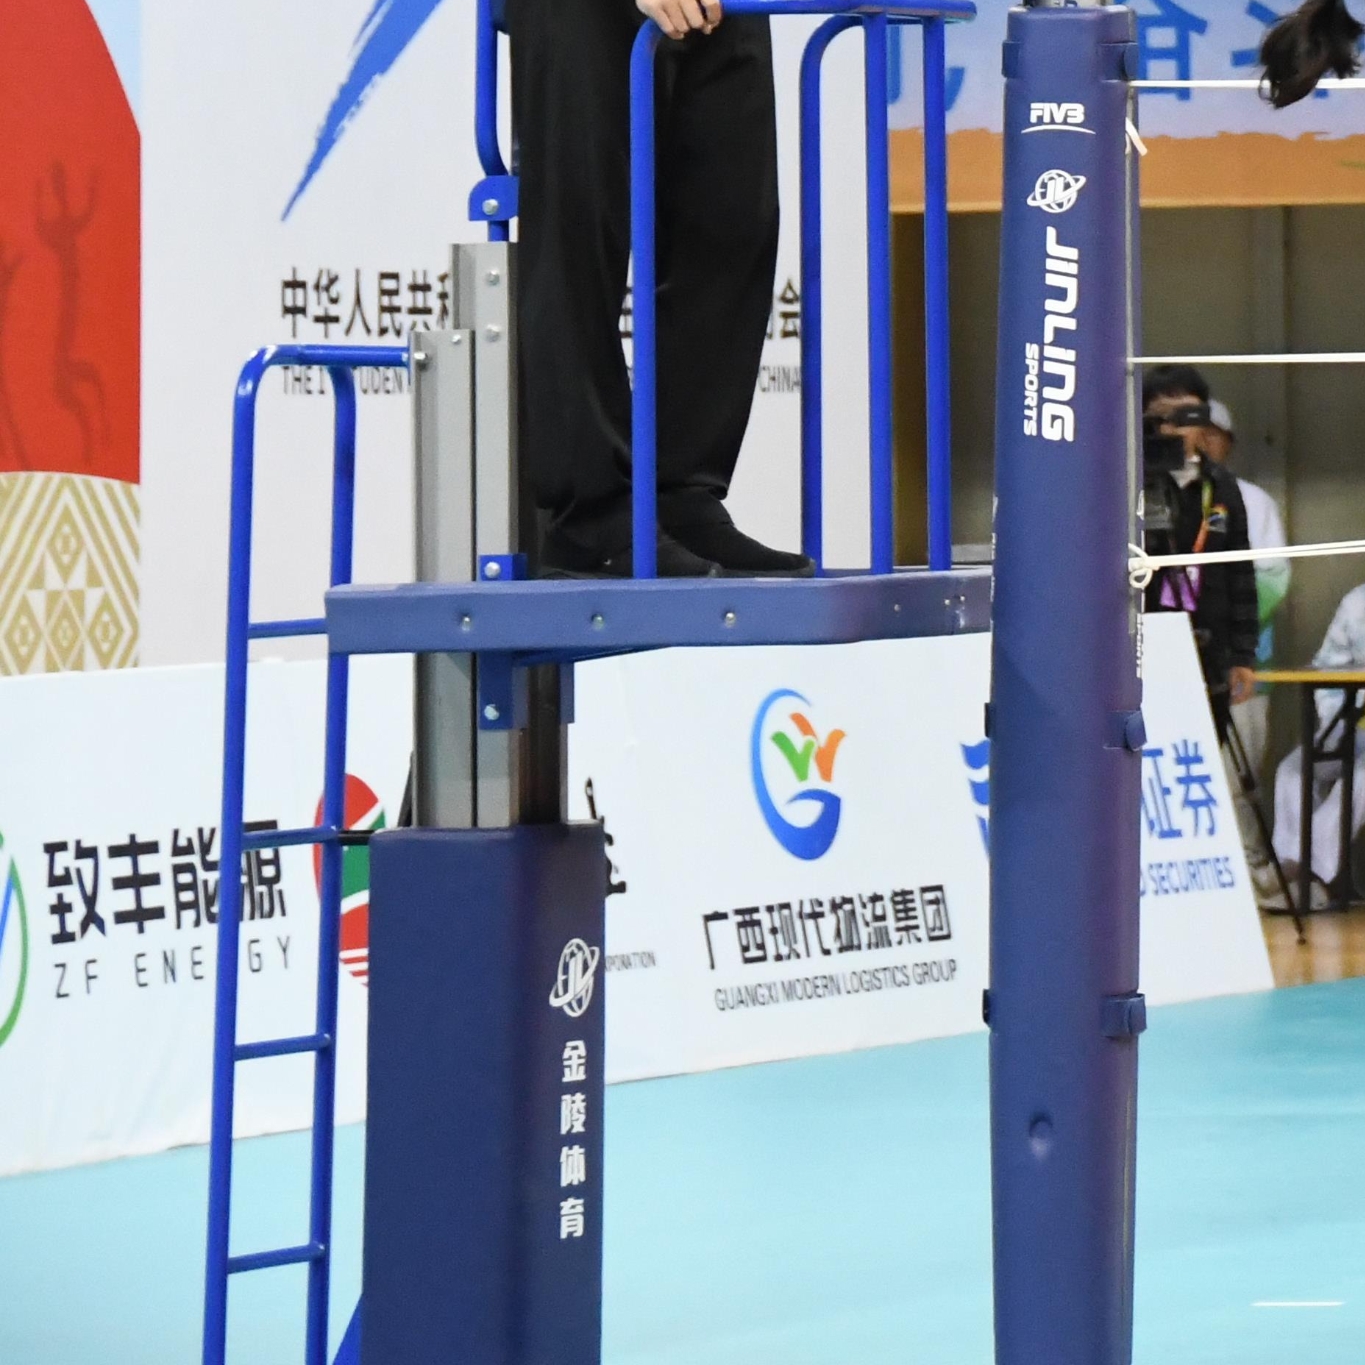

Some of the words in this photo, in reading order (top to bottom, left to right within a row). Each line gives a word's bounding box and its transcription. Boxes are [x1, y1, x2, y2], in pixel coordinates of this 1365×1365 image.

[1029, 103, 1085, 124] FIVB
[1041, 225, 1079, 442] JINLING
[1023, 342, 1040, 437] SPORTS
[1148, 857, 1235, 896] SECURITIES
[702, 884, 952, 970] 广西现代物流集团
[55, 959, 100, 999] ZF
[135, 935, 292, 988] ENEGY
[714, 981, 779, 1012] GUANGXI
[781, 972, 841, 1003] MODERN
[841, 964, 911, 995] LOGISTICS
[912, 958, 957, 985] GROUP
[559, 1040, 587, 1240] 金陵体育
